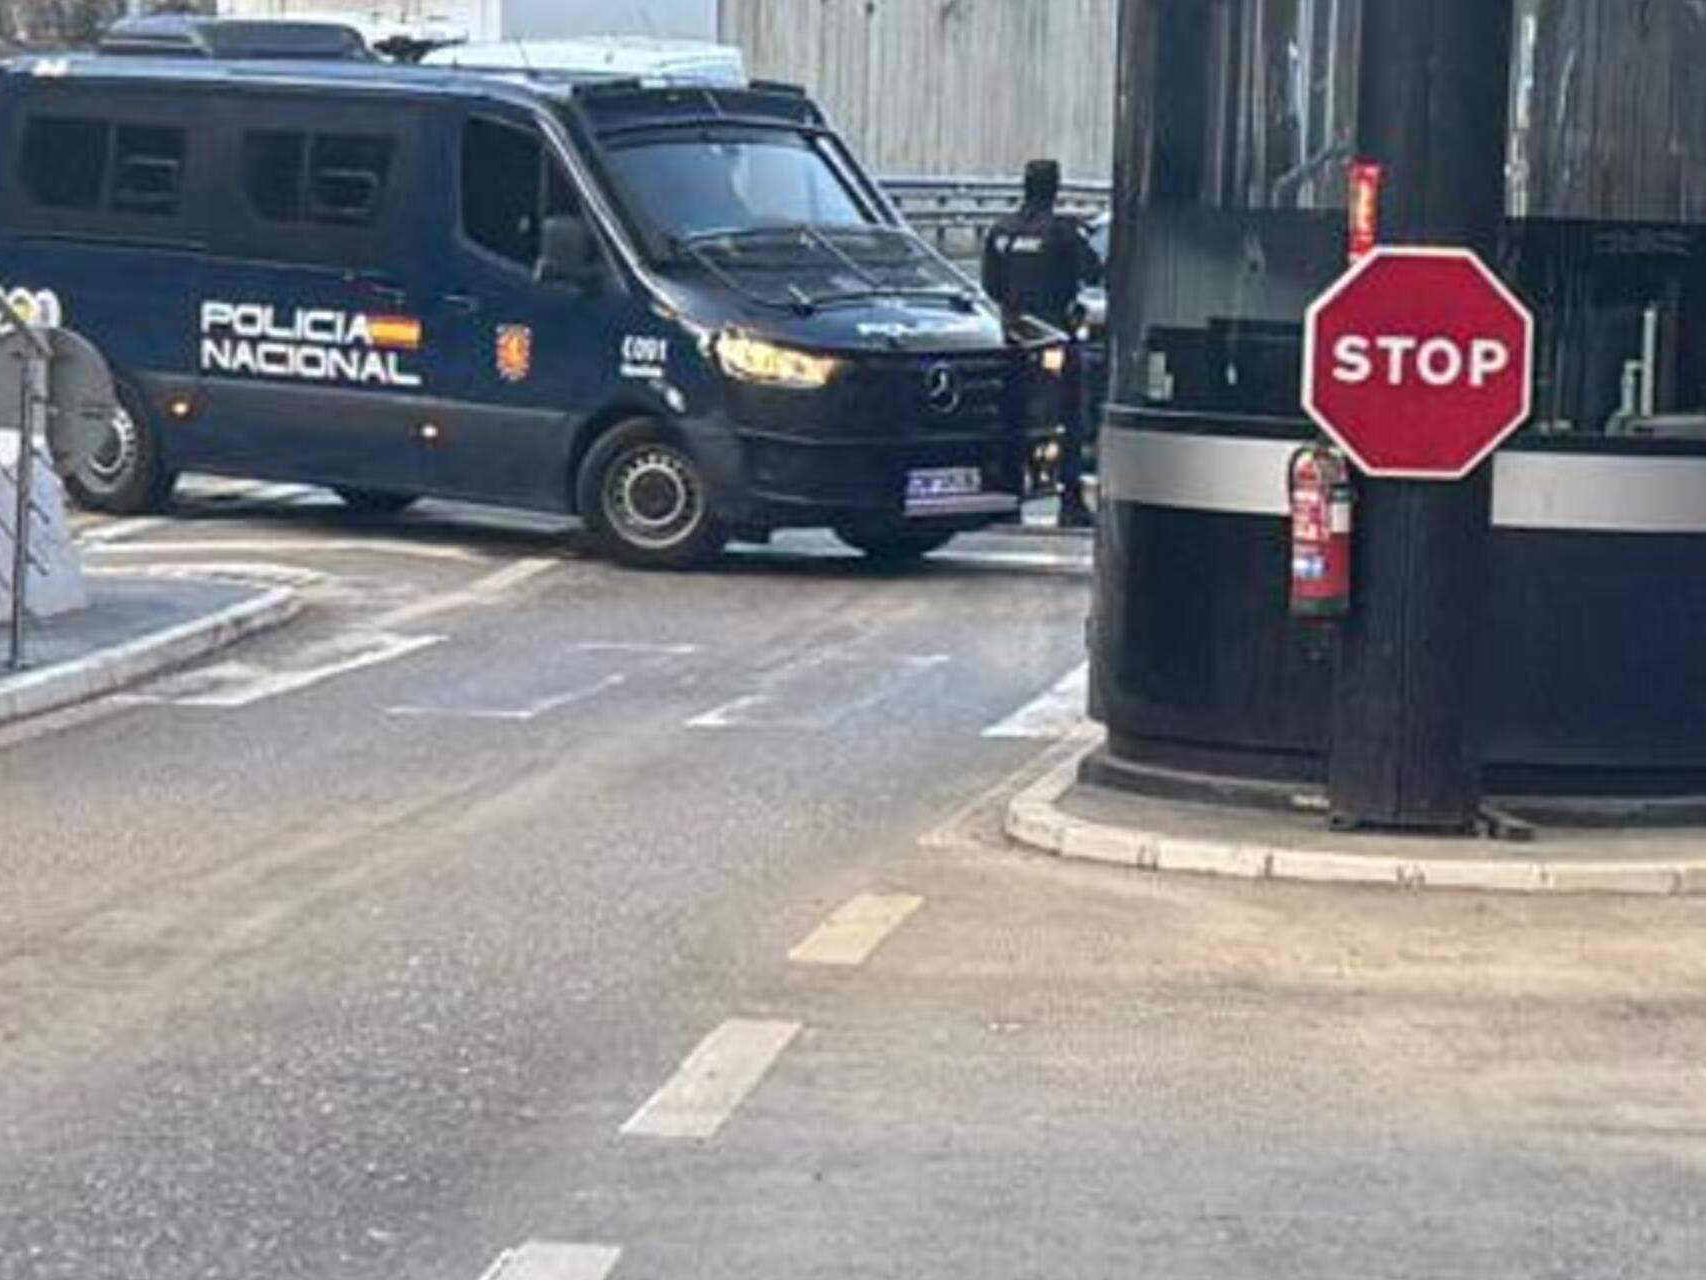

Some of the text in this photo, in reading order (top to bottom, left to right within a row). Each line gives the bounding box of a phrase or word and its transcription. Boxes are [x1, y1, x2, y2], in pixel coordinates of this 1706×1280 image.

[200, 301, 374, 345] POLICIA
[200, 338, 422, 386] NACIONAL
[1332, 335, 1508, 386] STOP
